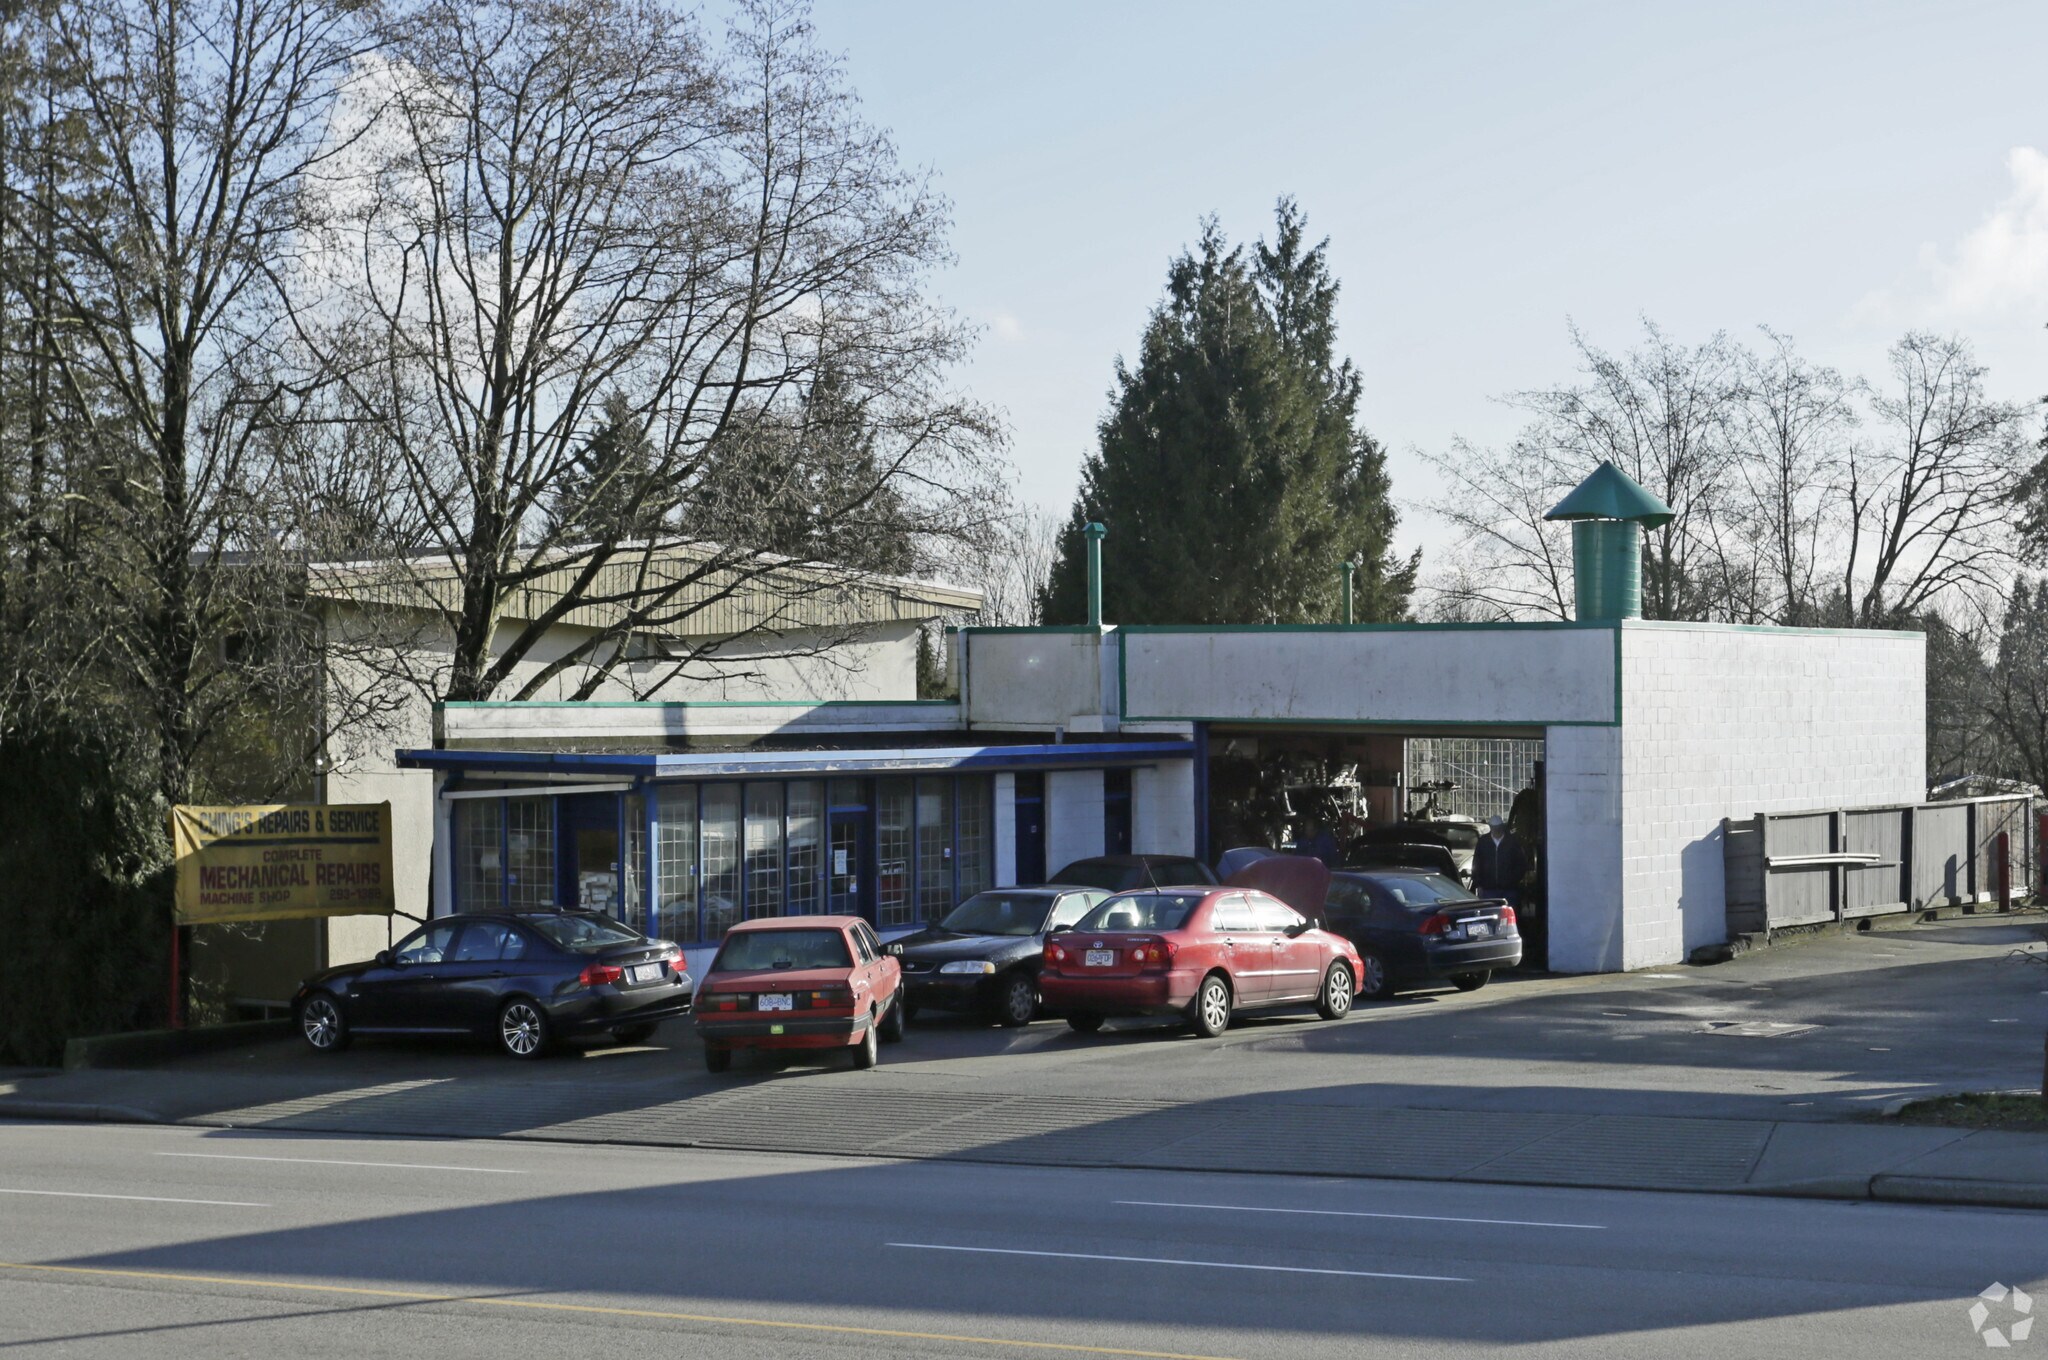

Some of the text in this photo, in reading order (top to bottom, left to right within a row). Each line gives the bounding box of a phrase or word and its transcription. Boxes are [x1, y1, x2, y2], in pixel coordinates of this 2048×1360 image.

[259, 810, 310, 834] REPAIRS
[315, 811, 324, 833] &
[330, 811, 379, 833] SERVICE
[263, 849, 322, 863] COMPLETE
[200, 863, 381, 890] MECHANICAL REPAIRS
[200, 891, 254, 905] MACHINE
[259, 890, 290, 904] SHOP
